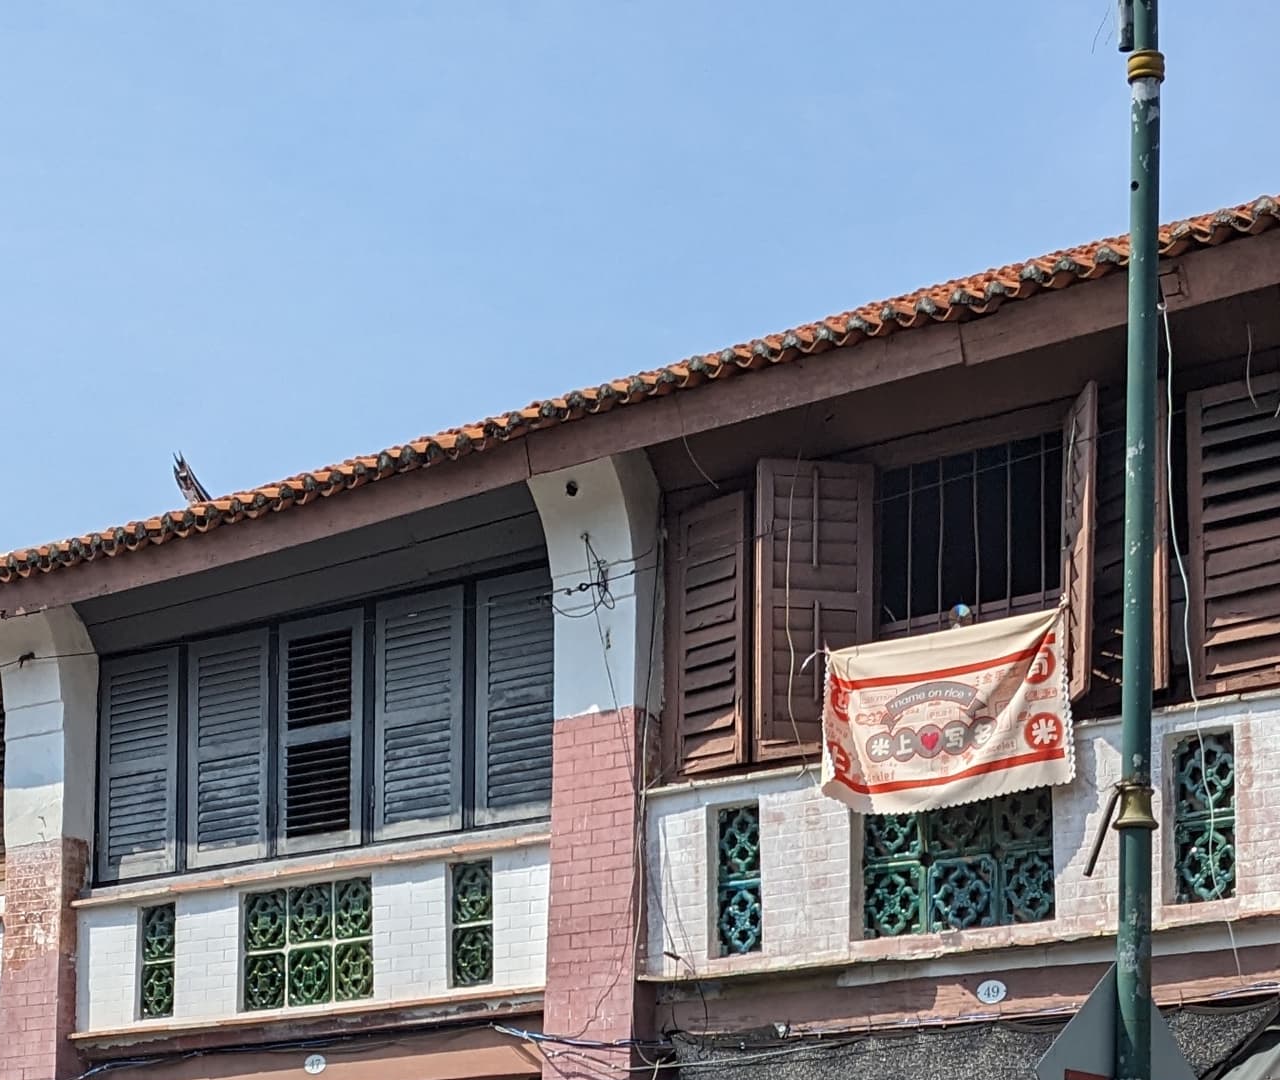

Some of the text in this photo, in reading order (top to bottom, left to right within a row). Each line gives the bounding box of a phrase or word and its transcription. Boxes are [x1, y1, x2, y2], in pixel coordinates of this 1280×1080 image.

[927, 689, 942, 698] on
[944, 687, 965, 698] rice
[983, 984, 1000, 999] 49
